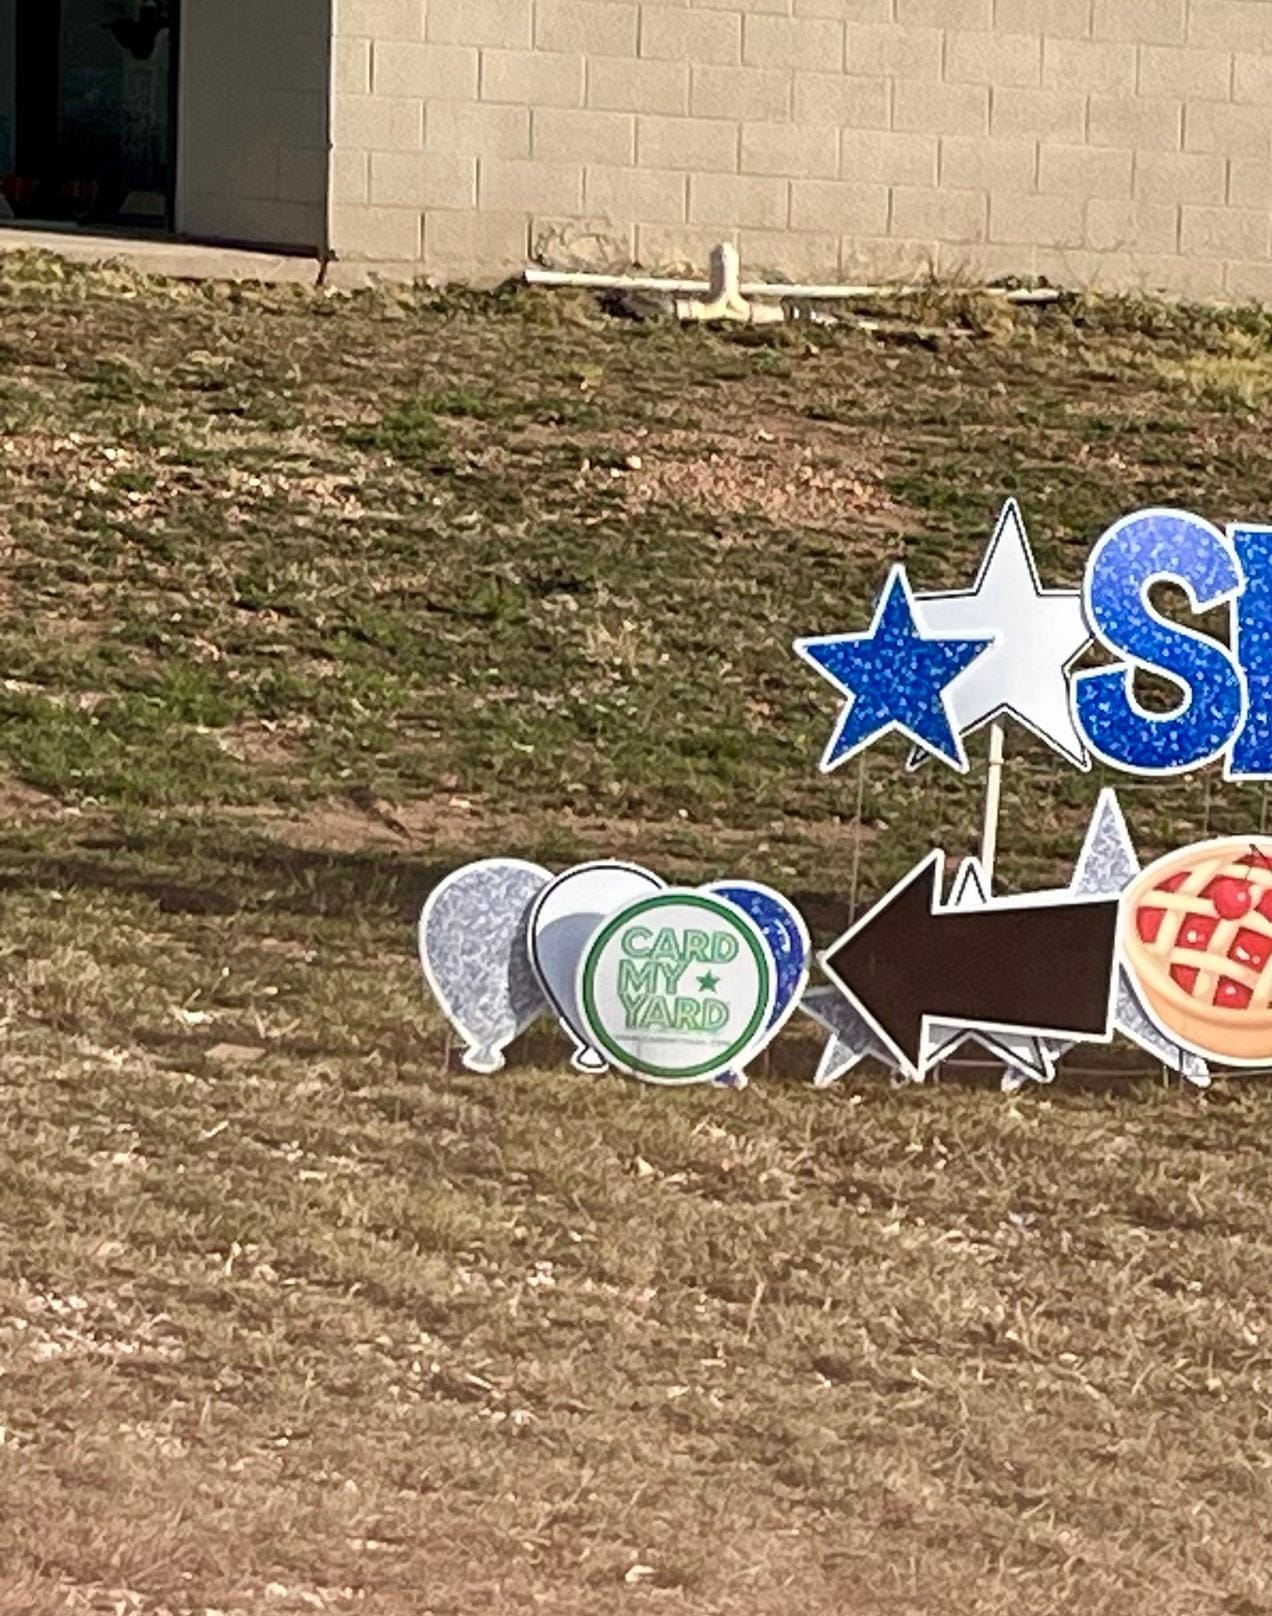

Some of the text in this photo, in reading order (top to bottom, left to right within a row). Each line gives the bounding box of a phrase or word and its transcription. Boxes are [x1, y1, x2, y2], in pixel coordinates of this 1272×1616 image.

[621, 926, 739, 963] CARD
[617, 958, 692, 994] MY
[618, 993, 729, 1032] YARD
